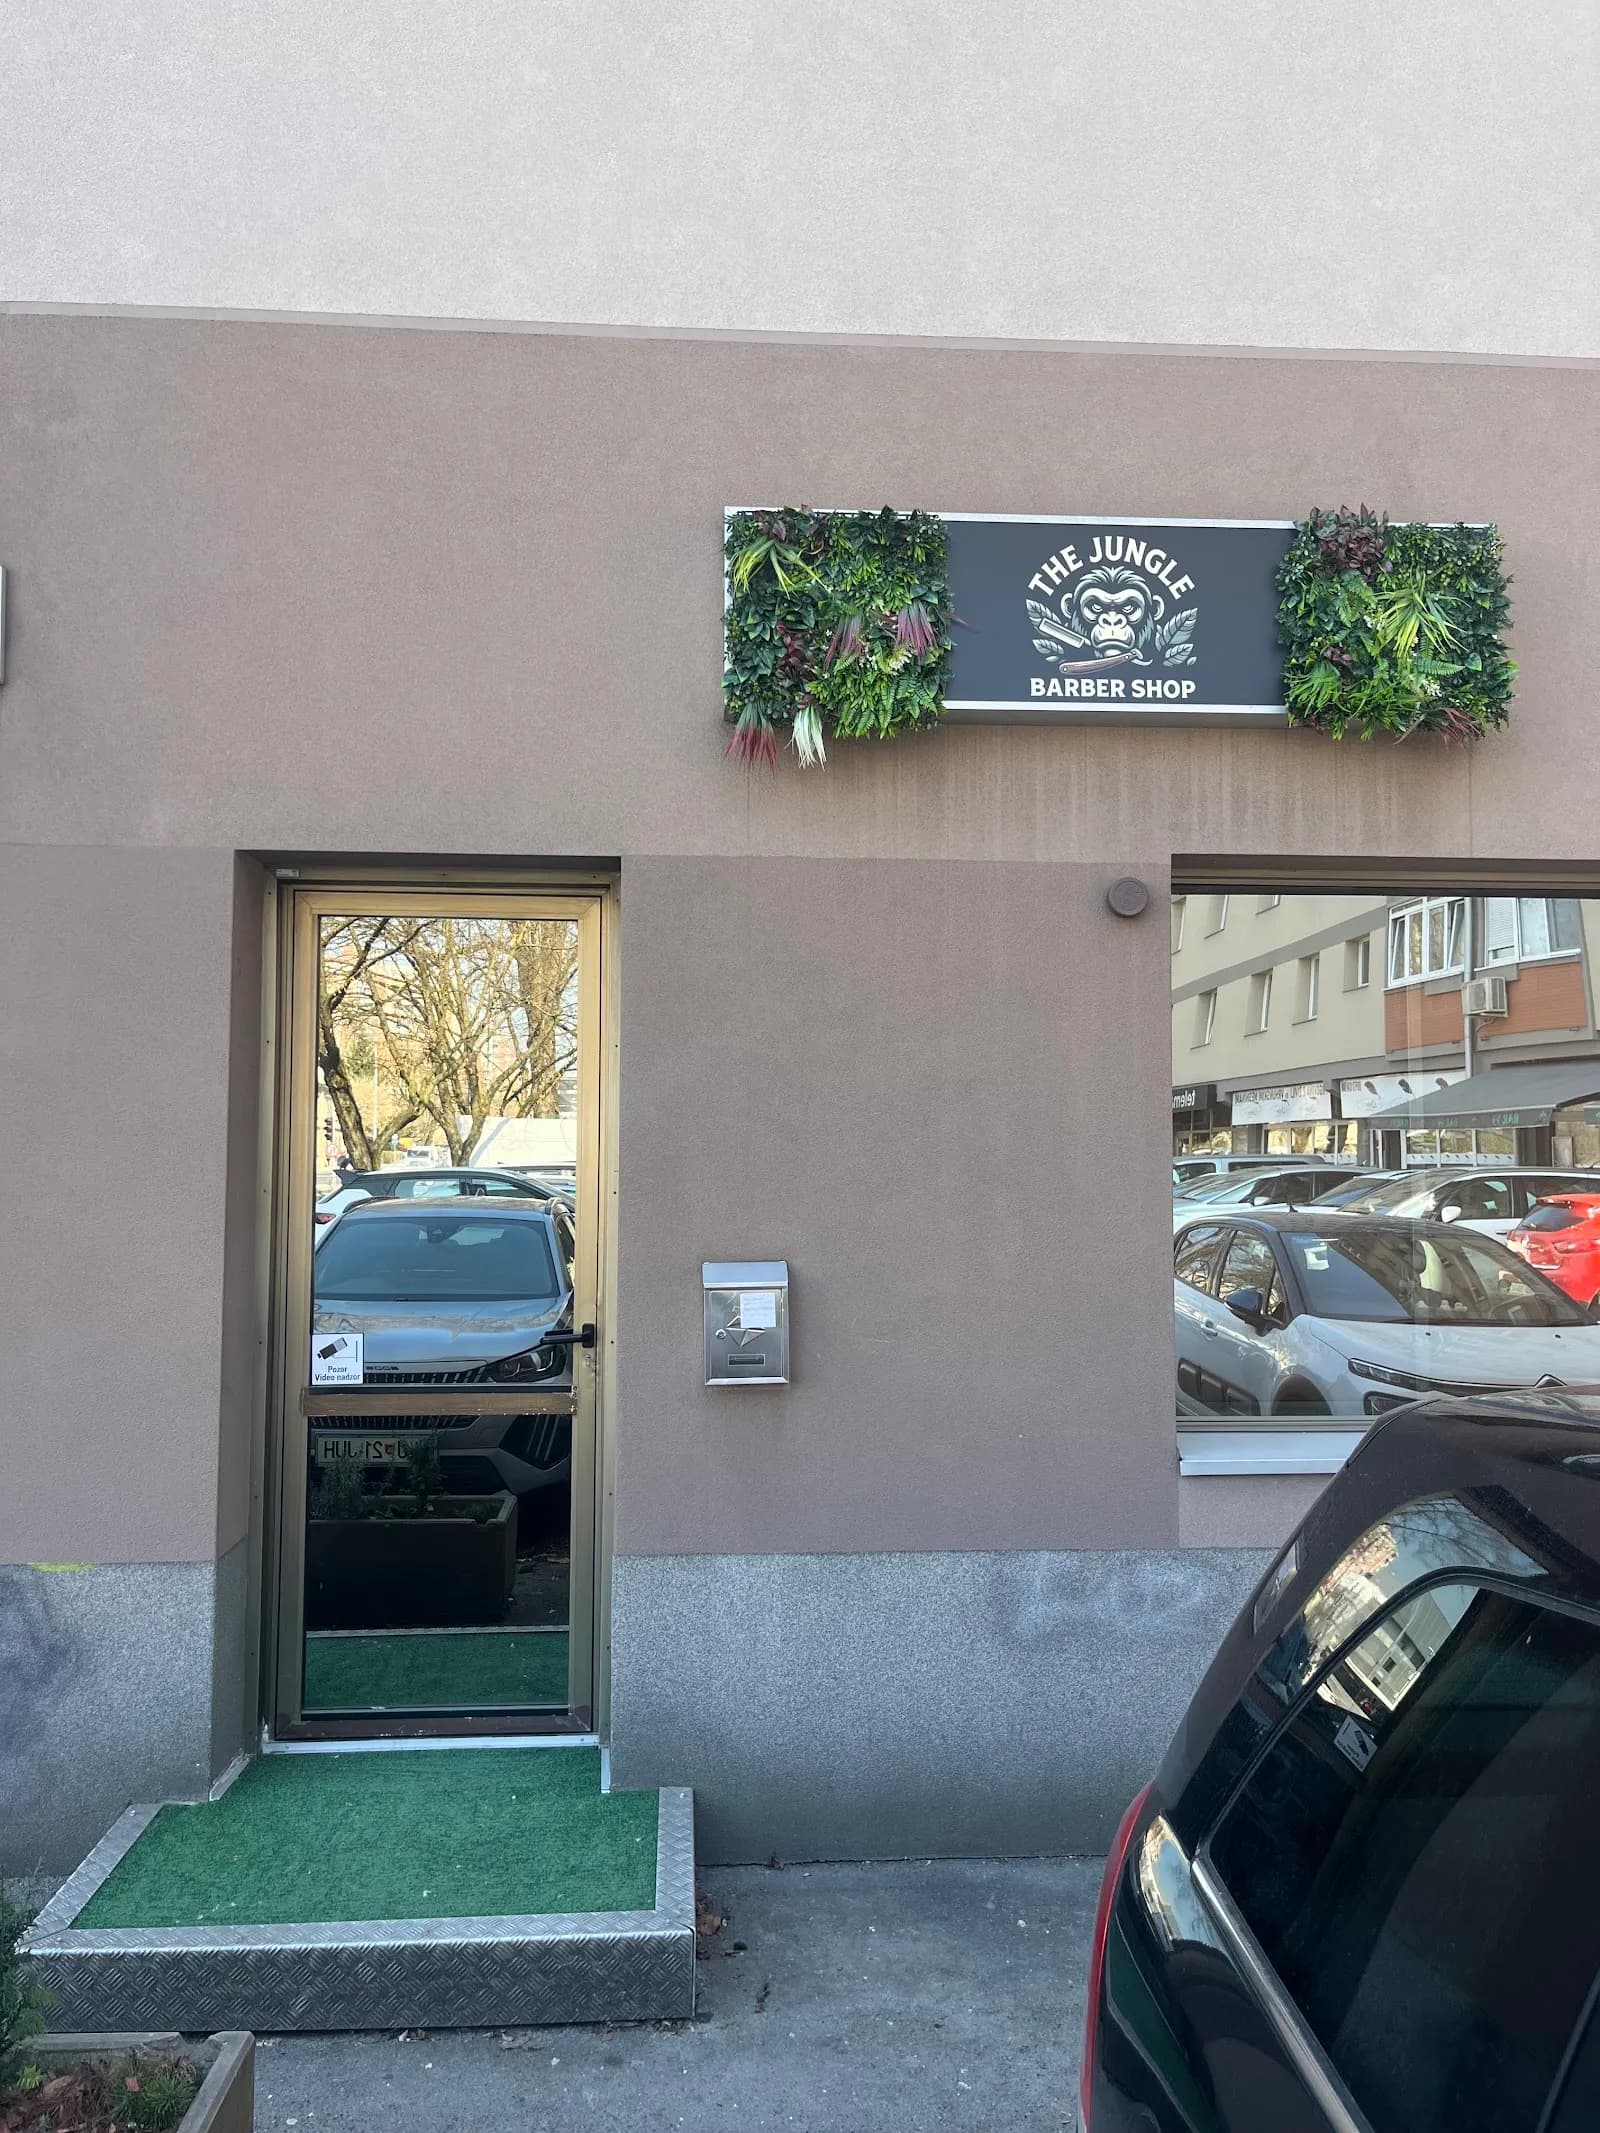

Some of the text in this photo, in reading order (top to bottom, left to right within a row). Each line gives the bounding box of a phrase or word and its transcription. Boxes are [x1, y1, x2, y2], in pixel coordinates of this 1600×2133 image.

[1028, 536, 1195, 600] THE JUNGLE
[1030, 678, 1196, 698] BARBER SHOP
[315, 1373, 361, 1381] Video nadzor
